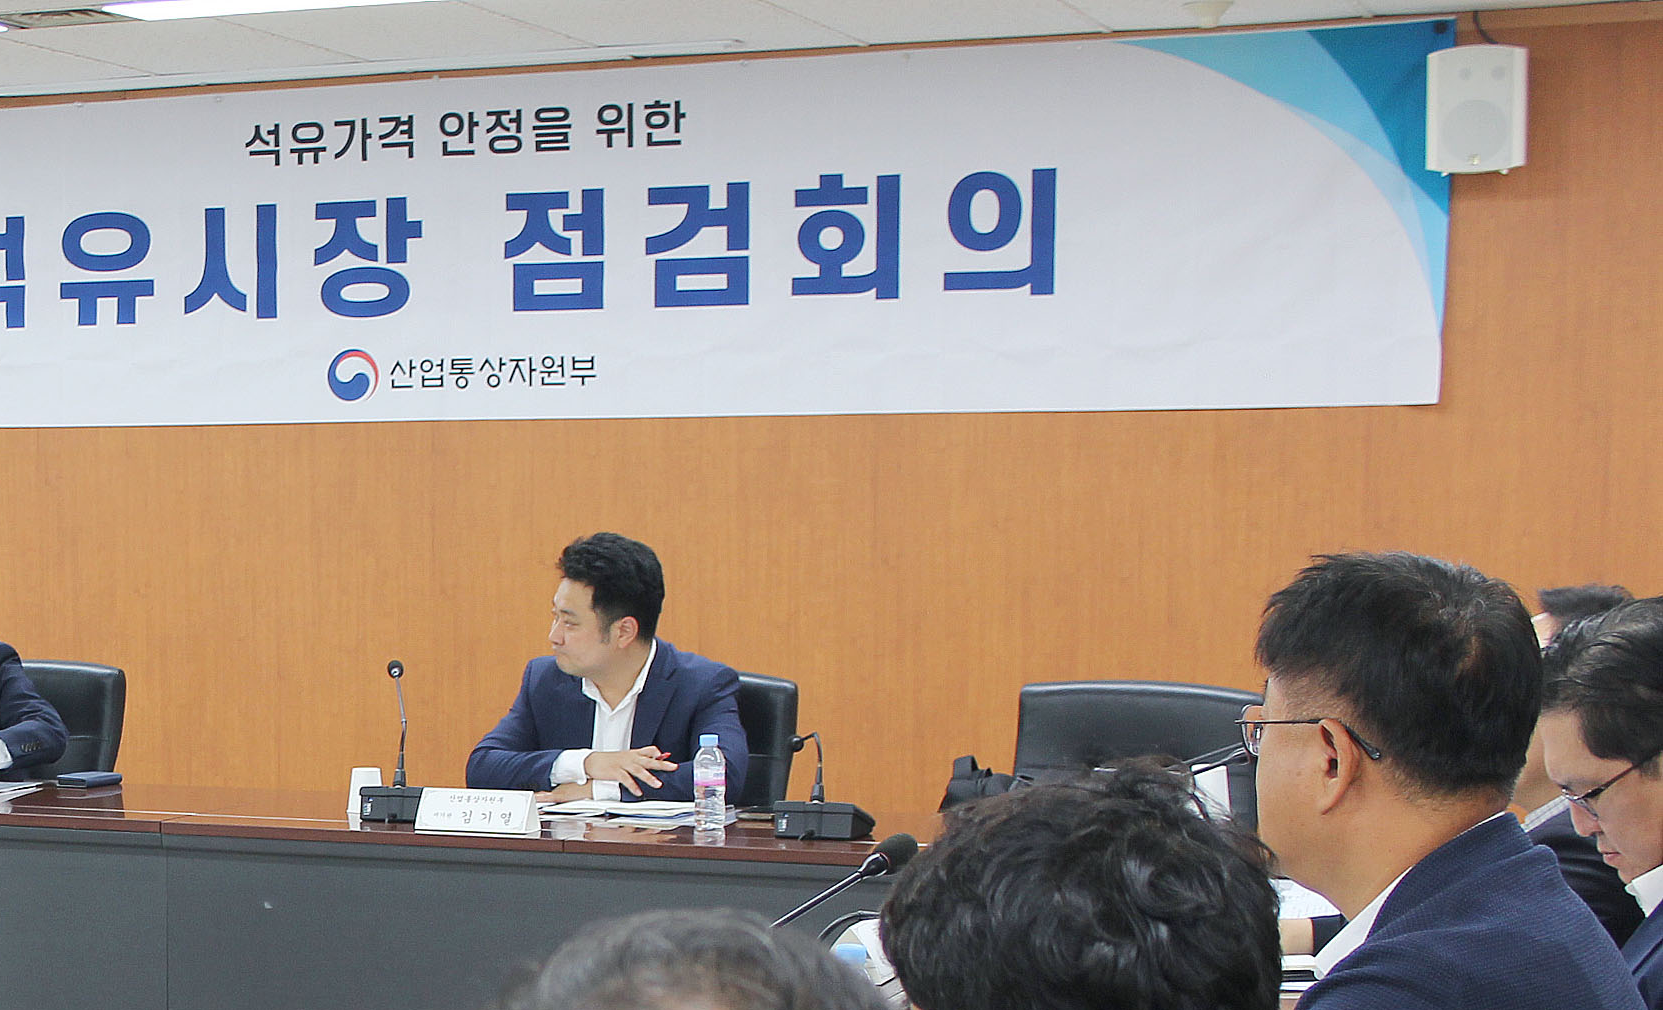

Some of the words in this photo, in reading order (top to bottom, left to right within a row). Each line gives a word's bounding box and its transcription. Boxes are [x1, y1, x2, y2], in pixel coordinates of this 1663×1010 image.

[245, 115, 415, 167] 석유가격
[439, 107, 573, 157] 안정을
[595, 99, 687, 149] 위한
[505, 166, 1059, 312] 점검회의
[391, 355, 598, 390] 산업통상자원부
[449, 794, 504, 804] 산업통상자원부
